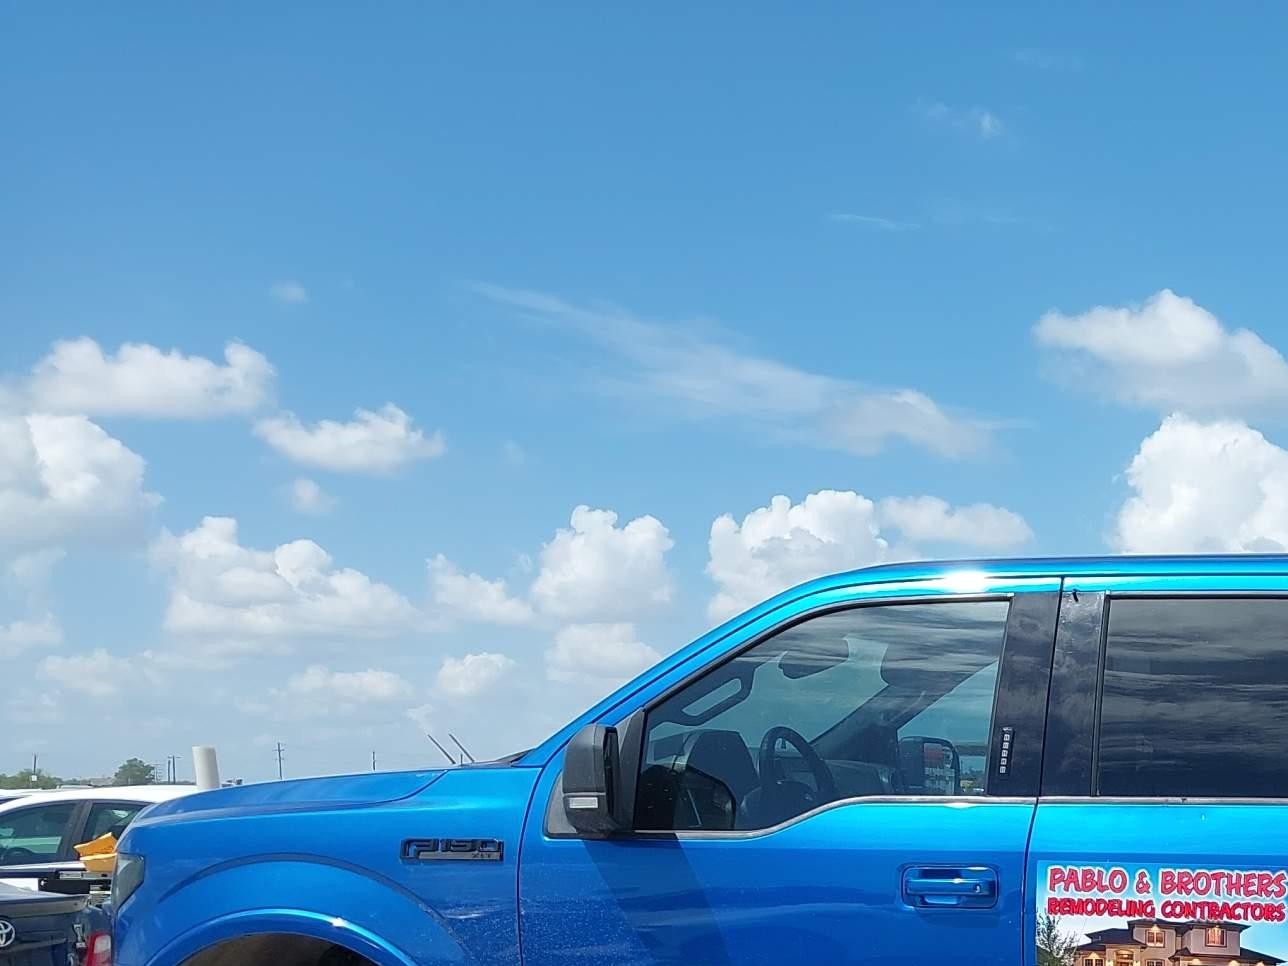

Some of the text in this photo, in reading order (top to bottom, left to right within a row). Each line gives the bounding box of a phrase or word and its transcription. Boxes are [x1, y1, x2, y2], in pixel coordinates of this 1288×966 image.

[1048, 867, 1288, 898] PABLO & BROTHERS
[1048, 897, 1286, 922] REMODELING CONTRACTORS
